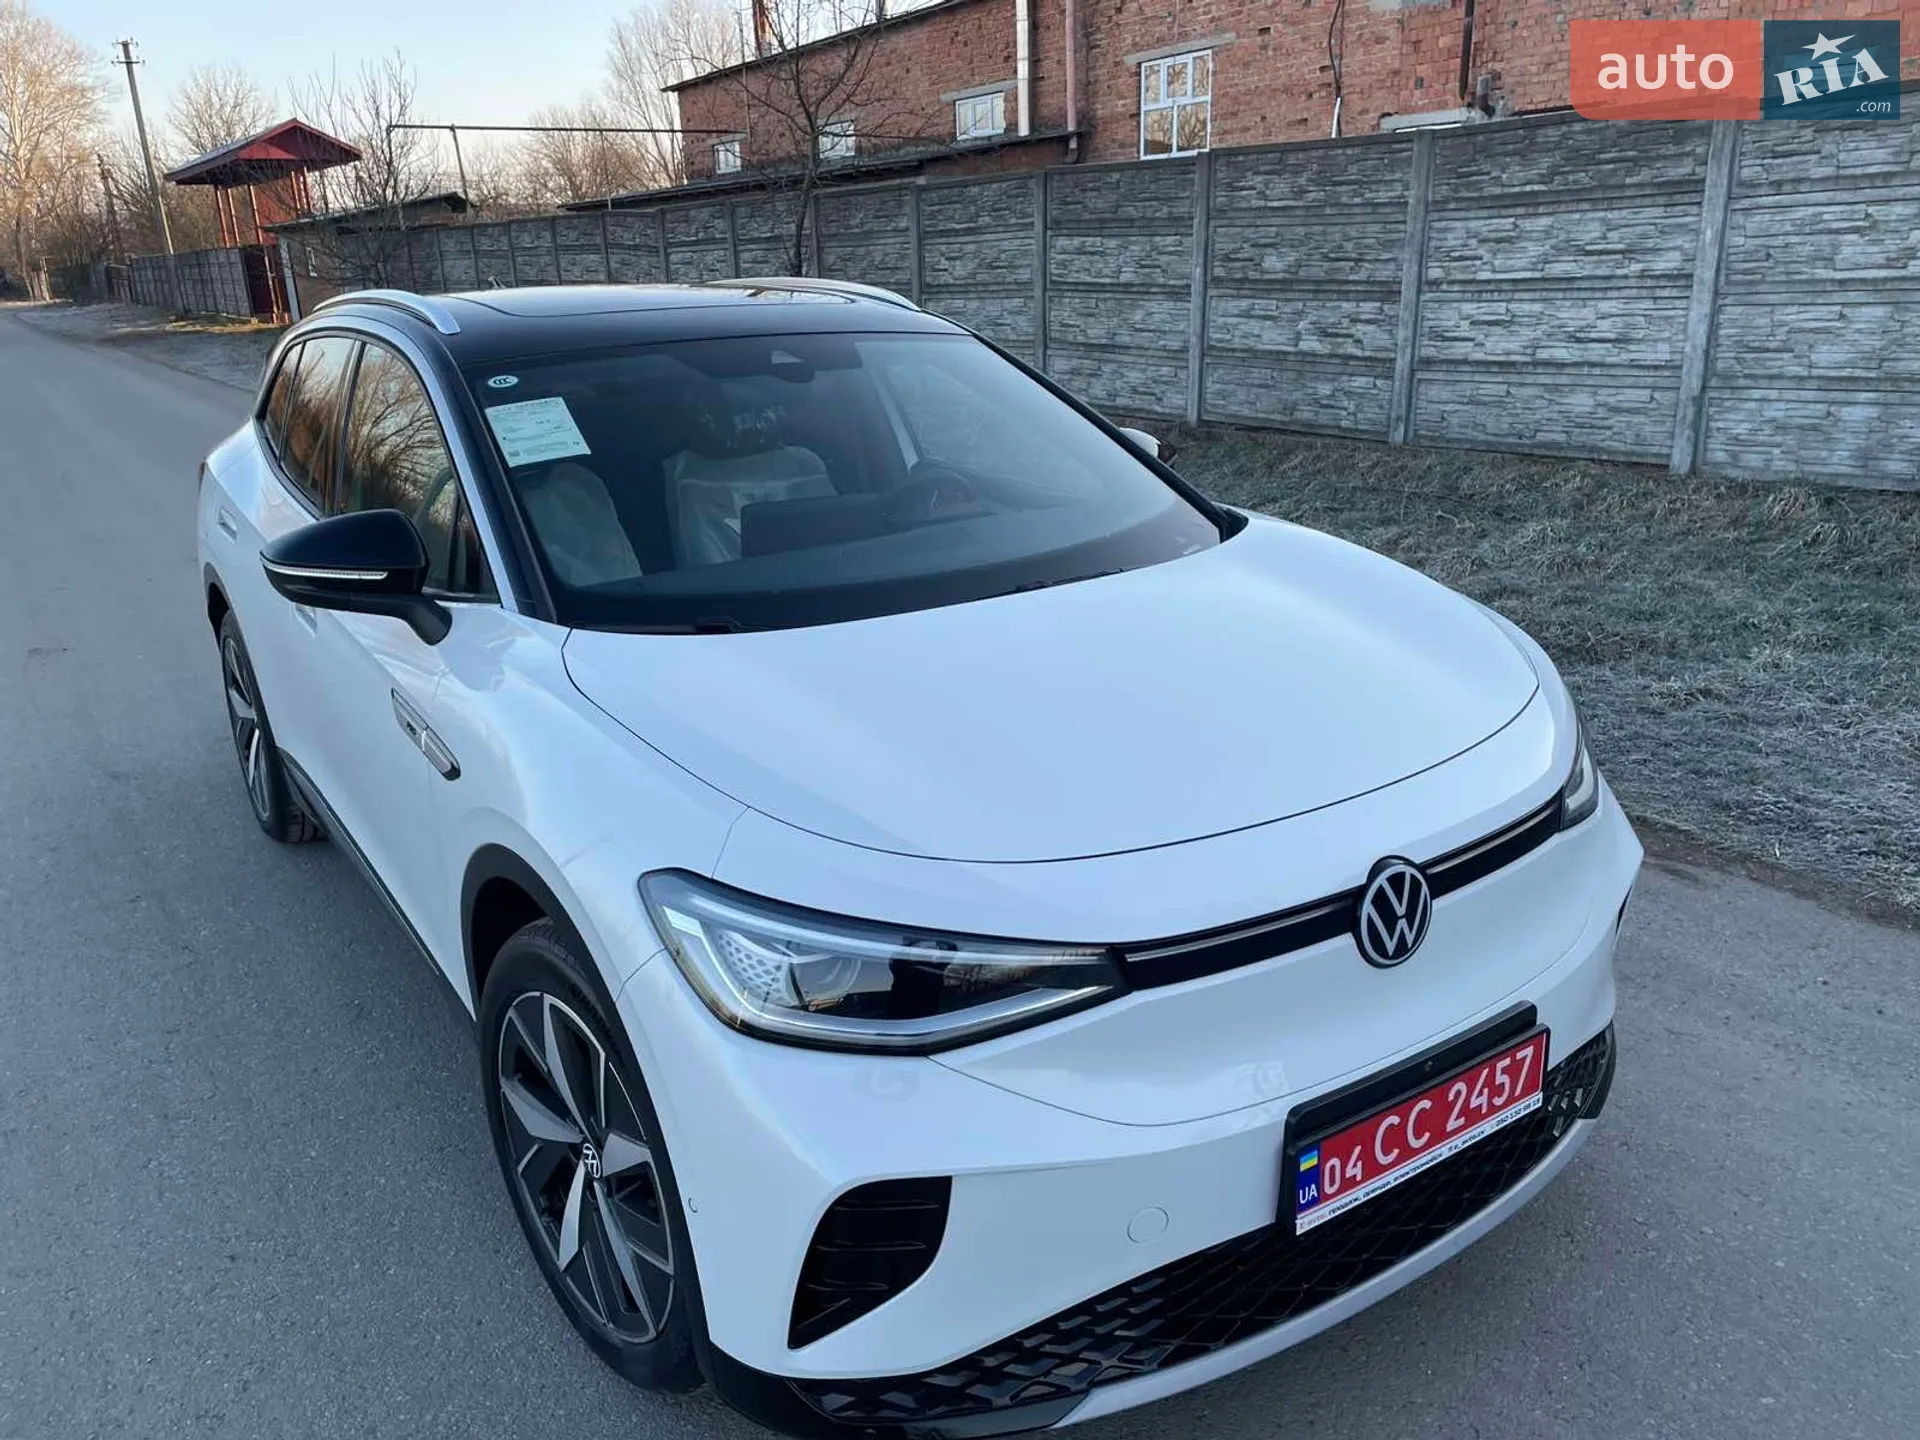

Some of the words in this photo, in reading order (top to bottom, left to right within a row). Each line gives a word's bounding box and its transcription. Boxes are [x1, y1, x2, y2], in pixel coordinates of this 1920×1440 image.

[1323, 1145, 1362, 1196] 04
[1374, 1099, 1433, 1166] CC
[1445, 1045, 1535, 1133] 2457
[1299, 1183, 1319, 1205] UA
